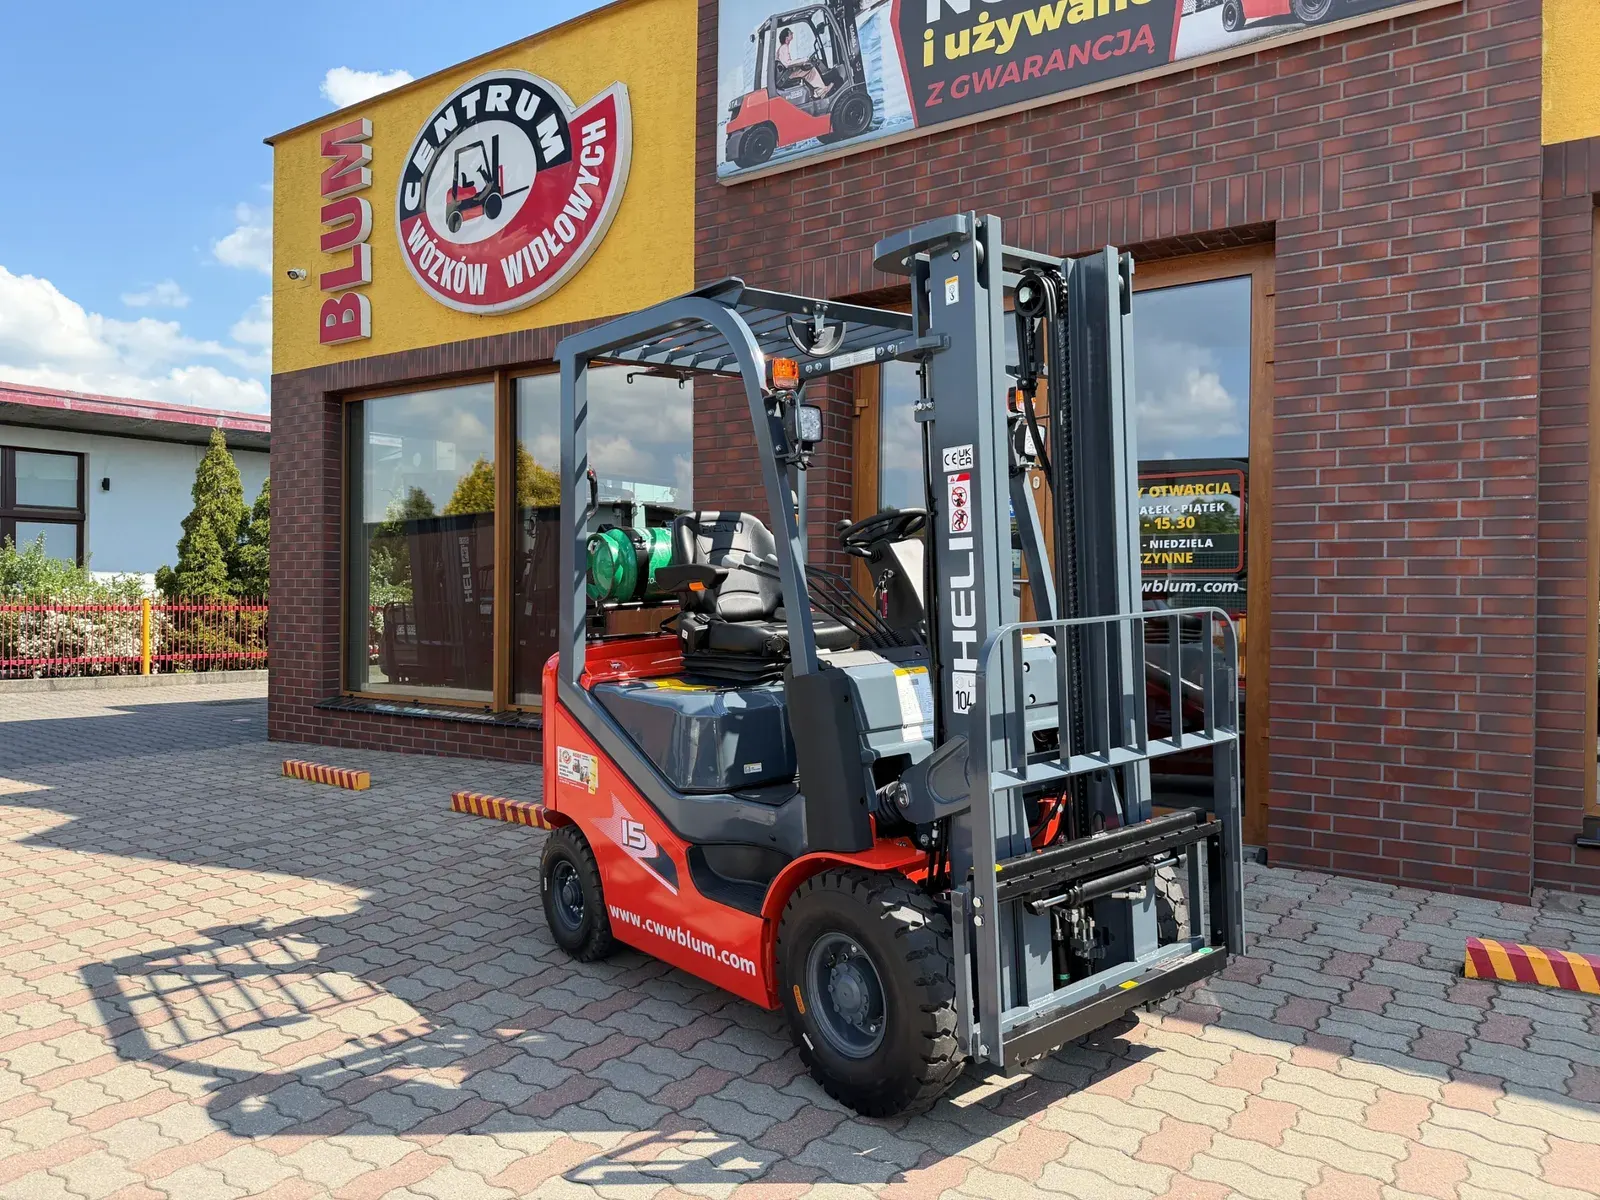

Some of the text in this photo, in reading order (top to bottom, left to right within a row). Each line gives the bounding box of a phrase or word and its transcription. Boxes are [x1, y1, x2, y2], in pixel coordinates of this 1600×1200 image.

[923, 28, 935, 68] i
[924, 23, 1156, 108] Z GWARANCJĄ
[404, 84, 565, 211] CENTRUM
[406, 117, 607, 296] WÓZKÓW WIDŁOWYCH
[319, 117, 372, 346] BLUM
[1149, 482, 1232, 498] OTWARCIA
[1139, 504, 1171, 515] AŁEK
[1181, 503, 1225, 515] PIĄTEK
[1154, 515, 1195, 530] 15.30
[1140, 552, 1193, 564] ZYNNE
[1149, 538, 1214, 549] NIEDZIELA
[949, 536, 978, 671] HELI
[1141, 579, 1239, 593] wblum.com
[620, 818, 647, 850] 15
[609, 904, 757, 977] www.cwwblum.com
